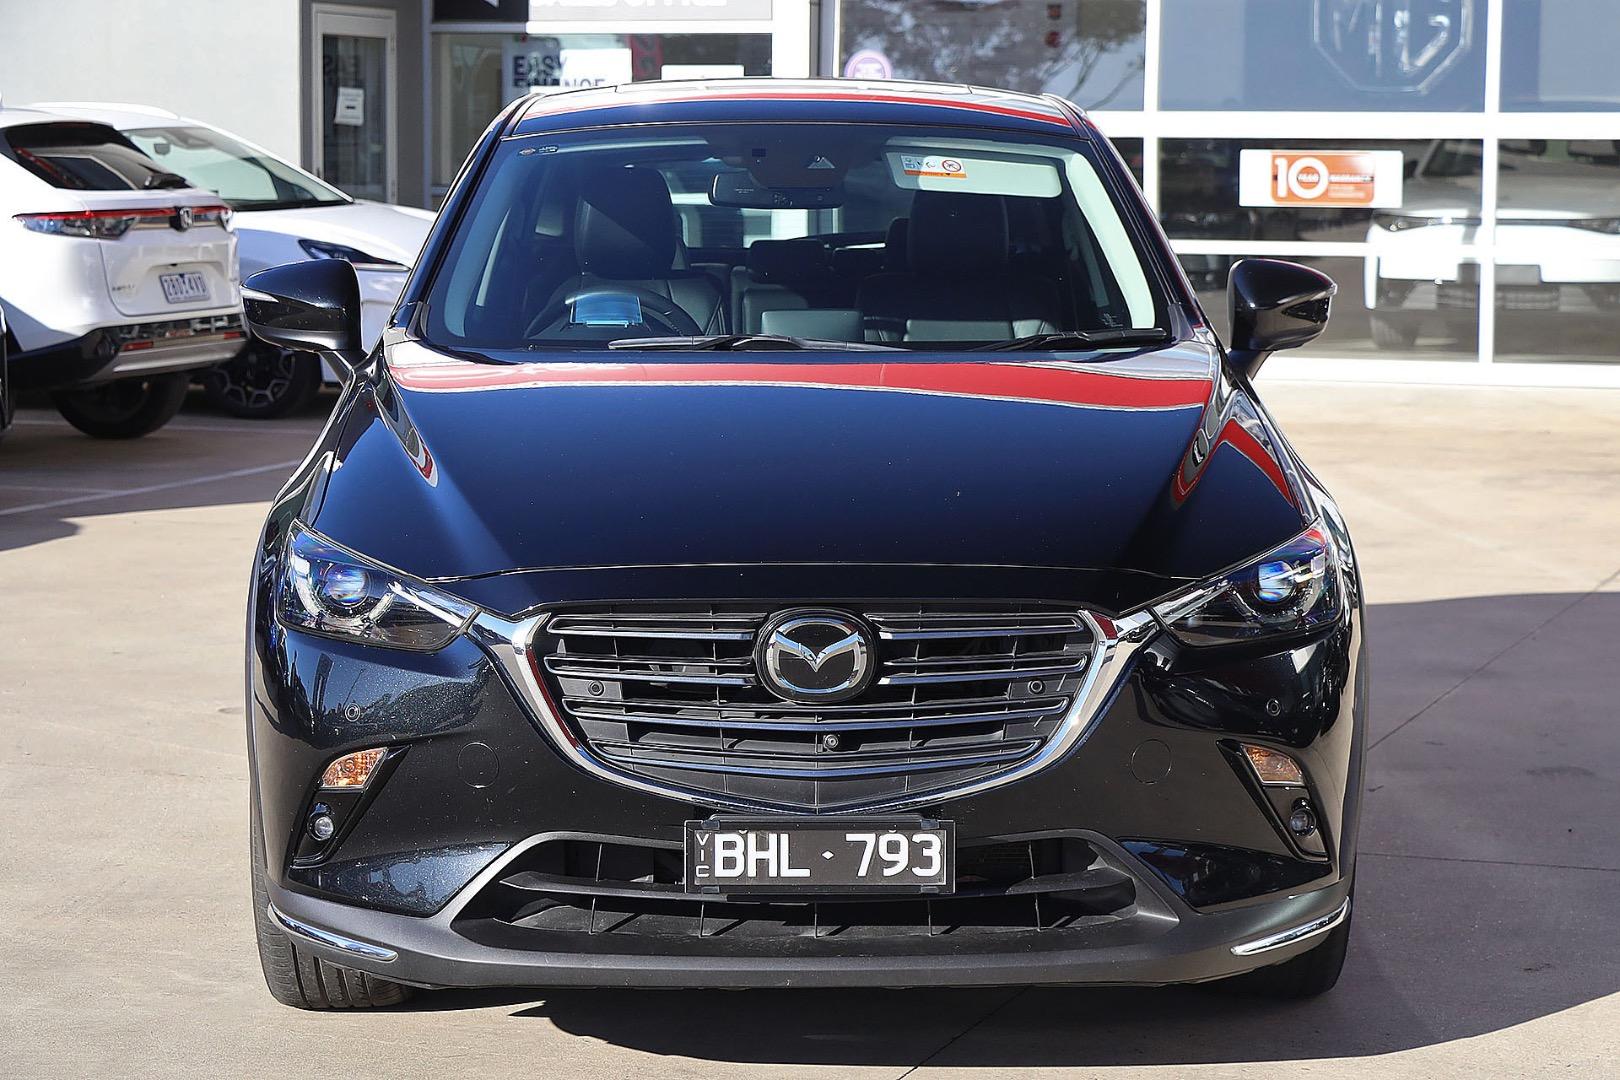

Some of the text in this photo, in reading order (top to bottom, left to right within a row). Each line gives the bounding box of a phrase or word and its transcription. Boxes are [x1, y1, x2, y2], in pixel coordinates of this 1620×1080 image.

[1274, 157, 1329, 200] 10
[695, 832, 710, 878] VIC
[714, 832, 942, 877] BHL 793
